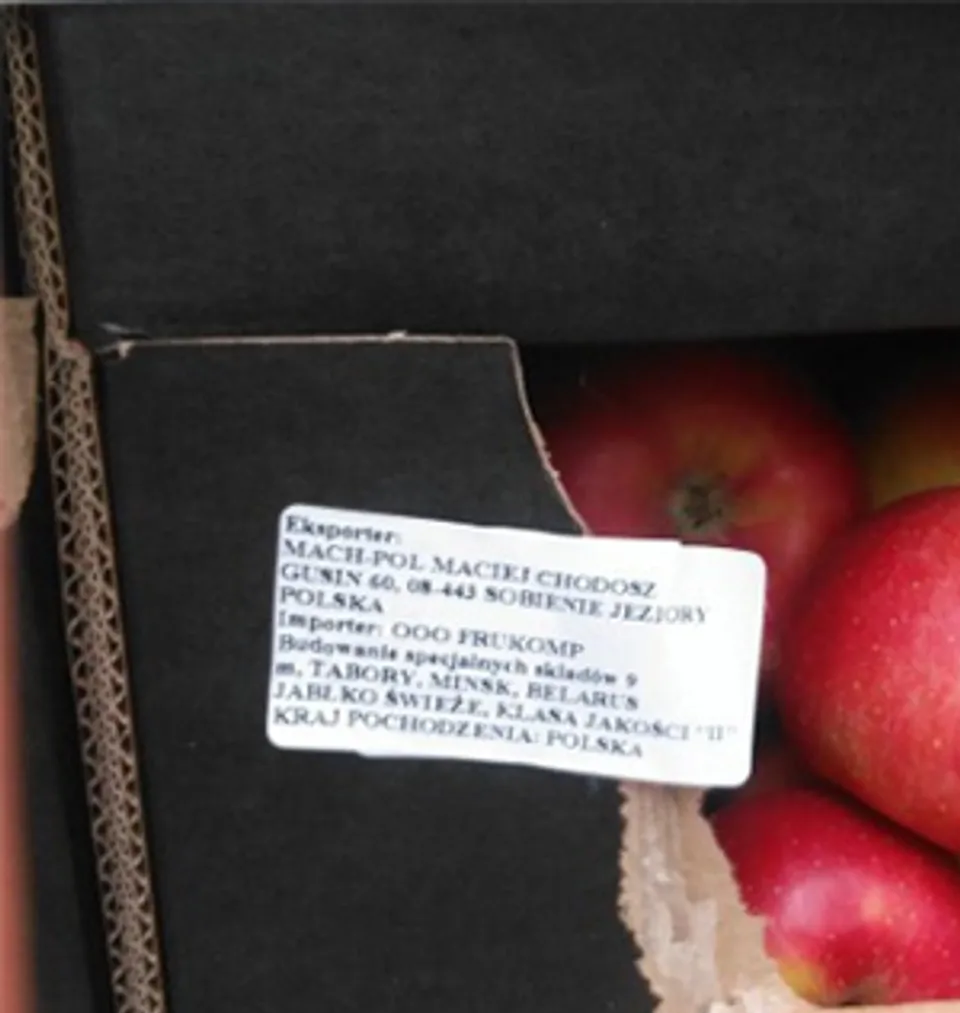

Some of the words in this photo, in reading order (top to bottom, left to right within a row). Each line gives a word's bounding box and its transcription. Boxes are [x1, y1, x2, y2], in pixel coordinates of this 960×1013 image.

[281, 562, 362, 588] GUSIN
[483, 585, 604, 619] SOBIENIE
[609, 602, 709, 624] JEZIORY
[431, 555, 530, 584] MACIEJ
[536, 569, 657, 599] CHODOSZ
[280, 585, 385, 615] POLSKA
[278, 611, 382, 638] Importer:
[457, 628, 585, 660] FRUKOMP
[405, 649, 528, 676] specjalnych
[497, 701, 577, 728] KLASA
[526, 681, 639, 711] BELARUS
[272, 706, 341, 728] KRAJ
[545, 730, 644, 760] POLSKA
